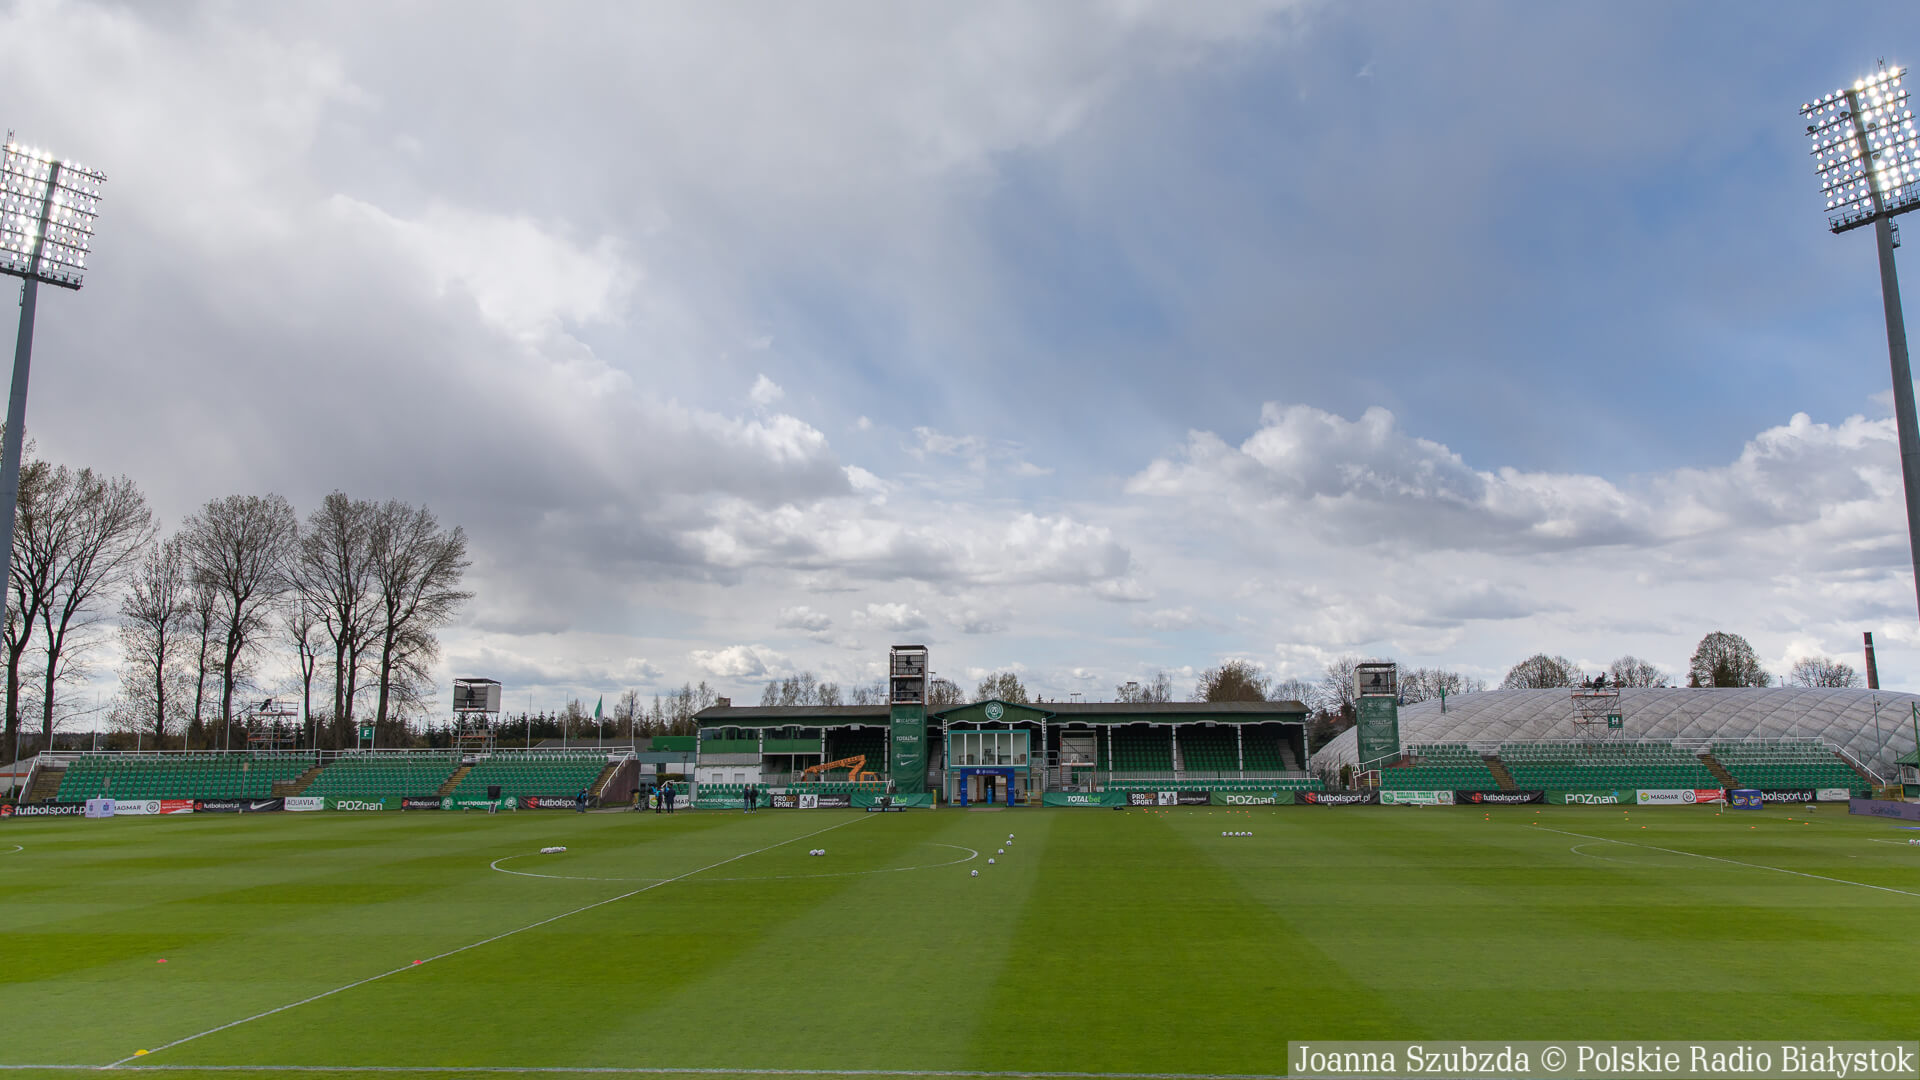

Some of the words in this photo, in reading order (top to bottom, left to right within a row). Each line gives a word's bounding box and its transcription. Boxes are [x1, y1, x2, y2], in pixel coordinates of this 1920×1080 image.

[1067, 794, 1101, 803] TOTALbet
[1227, 795, 1276, 805] POZnan
[1317, 793, 1371, 803] futbolsport.pl
[1483, 793, 1531, 802] futbolsport.pl
[1565, 793, 1618, 805] POZnan
[15, 804, 87, 817] futbolsport.p
[337, 800, 383, 811] POZnan
